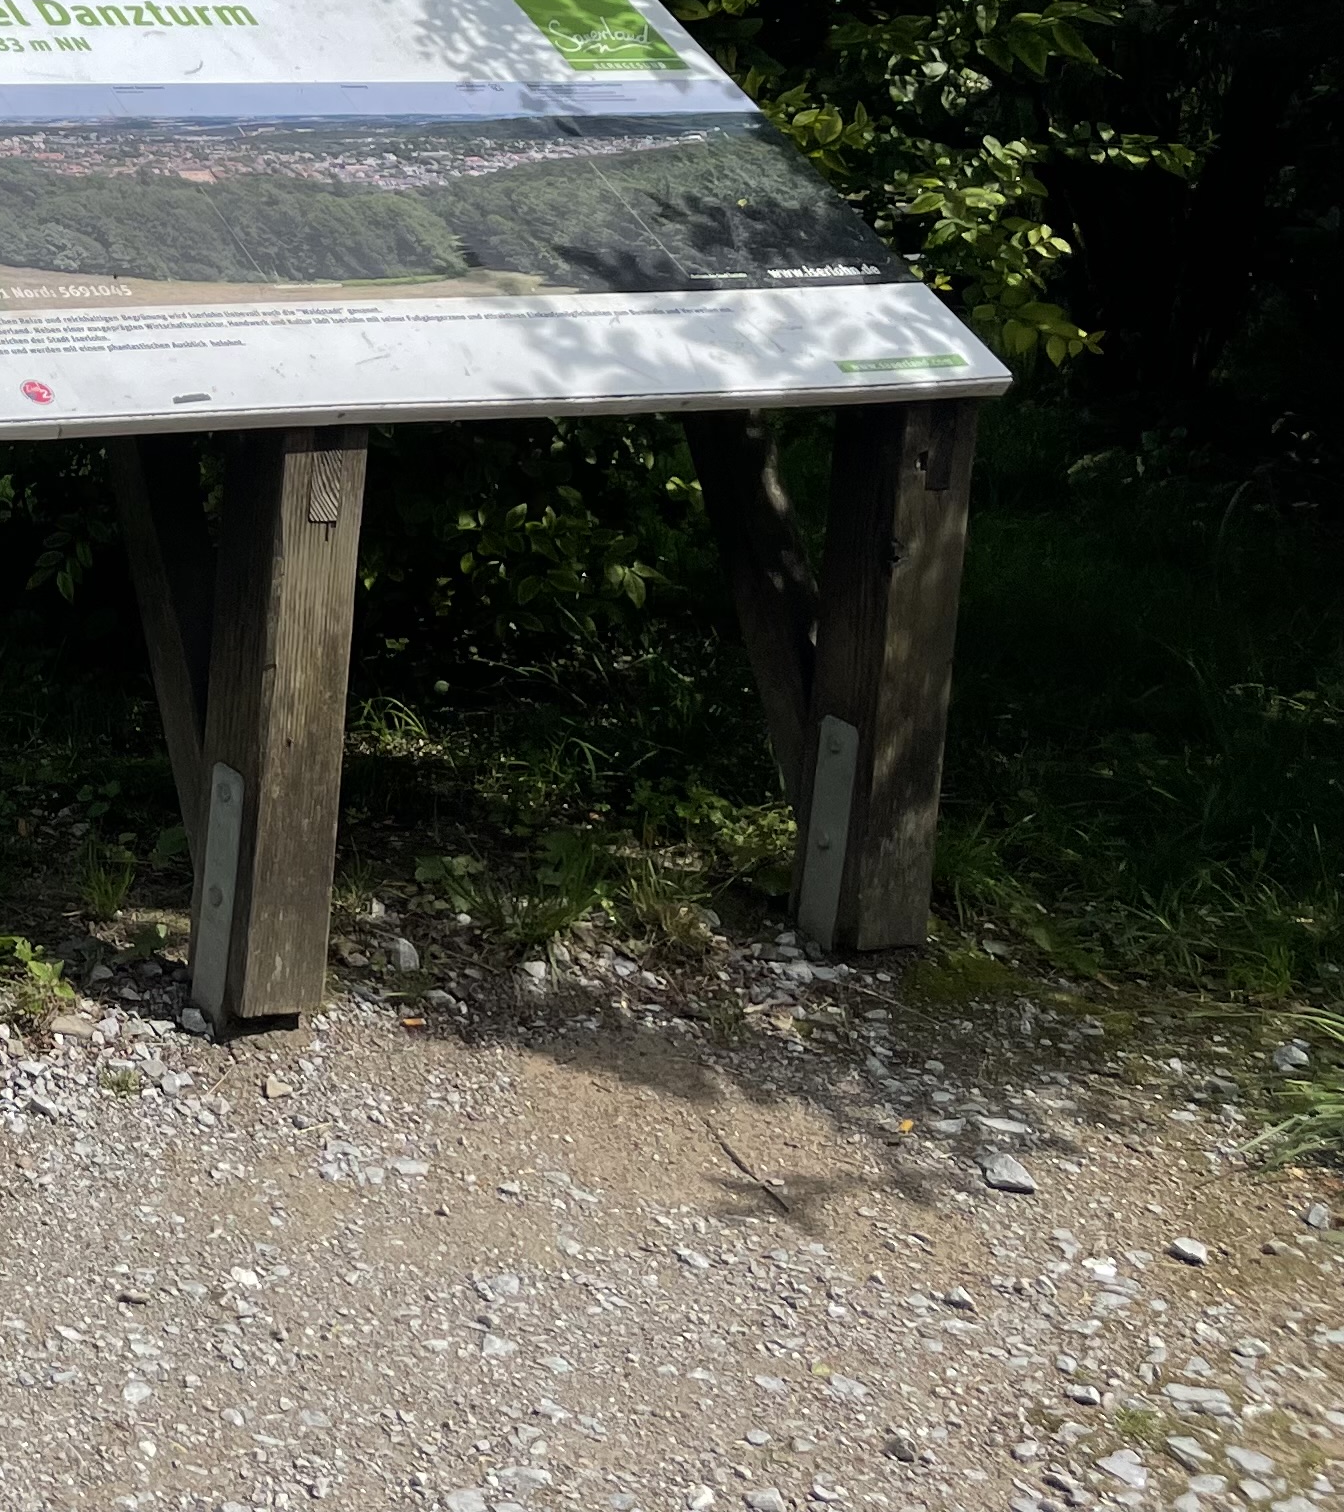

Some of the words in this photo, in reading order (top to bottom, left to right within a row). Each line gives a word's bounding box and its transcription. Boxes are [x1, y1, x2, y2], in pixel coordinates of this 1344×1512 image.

[32, 0, 259, 26] Danzturm
[29, 40, 52, 52] m
[54, 37, 92, 52] NN
[548, 16, 653, 53] Sauerland
[11, 285, 55, 299] Nord:
[58, 284, 133, 298] 5691045
